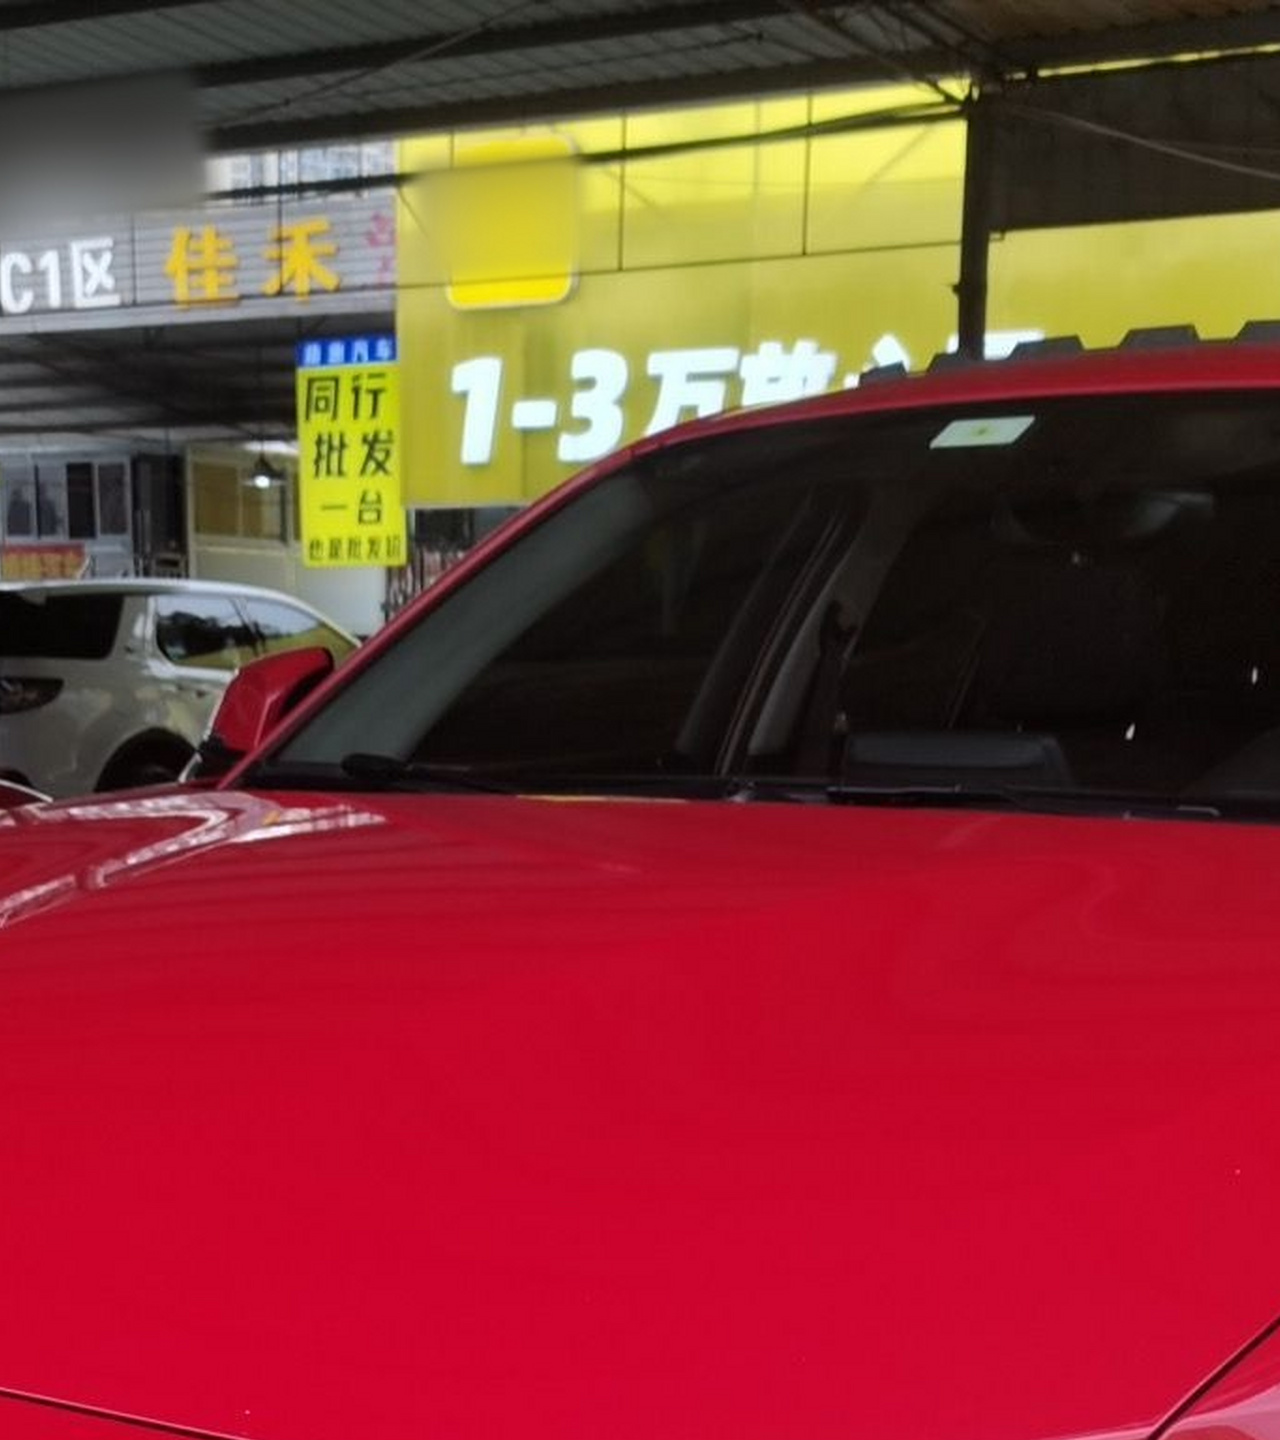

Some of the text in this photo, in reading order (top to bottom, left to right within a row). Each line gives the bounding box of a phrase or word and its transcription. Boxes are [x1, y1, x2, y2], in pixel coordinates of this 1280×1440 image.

[0, 237, 120, 316] C1区
[164, 214, 341, 313] 佳禾
[305, 373, 388, 421] 同行
[313, 430, 394, 477] 批发
[321, 489, 382, 525] 一台
